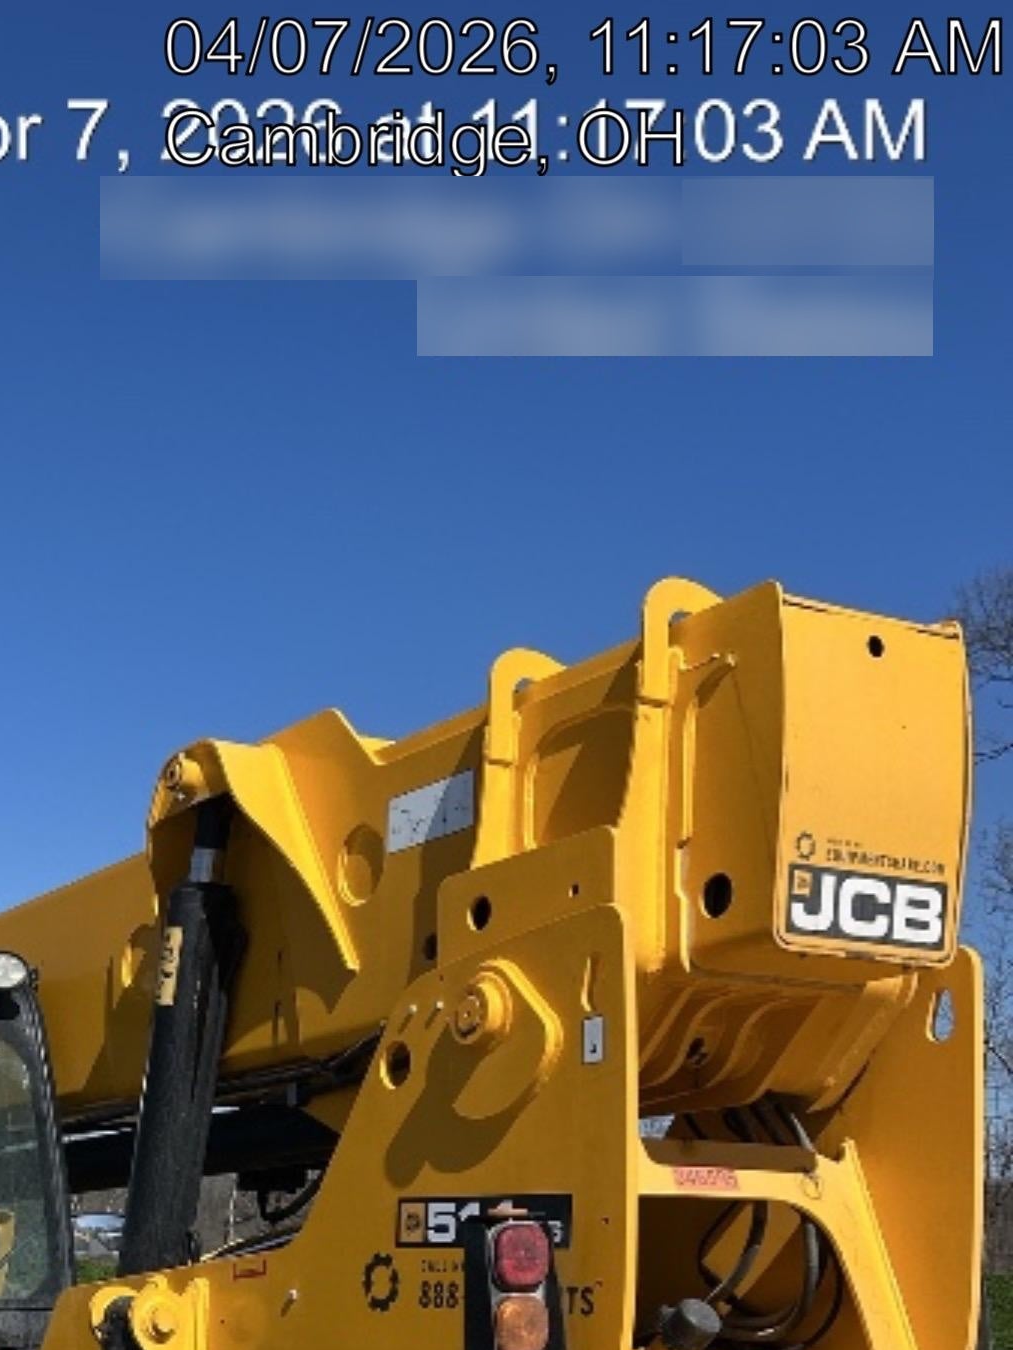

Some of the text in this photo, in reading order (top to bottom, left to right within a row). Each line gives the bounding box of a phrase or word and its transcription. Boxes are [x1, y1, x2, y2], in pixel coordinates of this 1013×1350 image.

[790, 873, 943, 944] JCB
[418, 1280, 595, 1317] 888 TS
